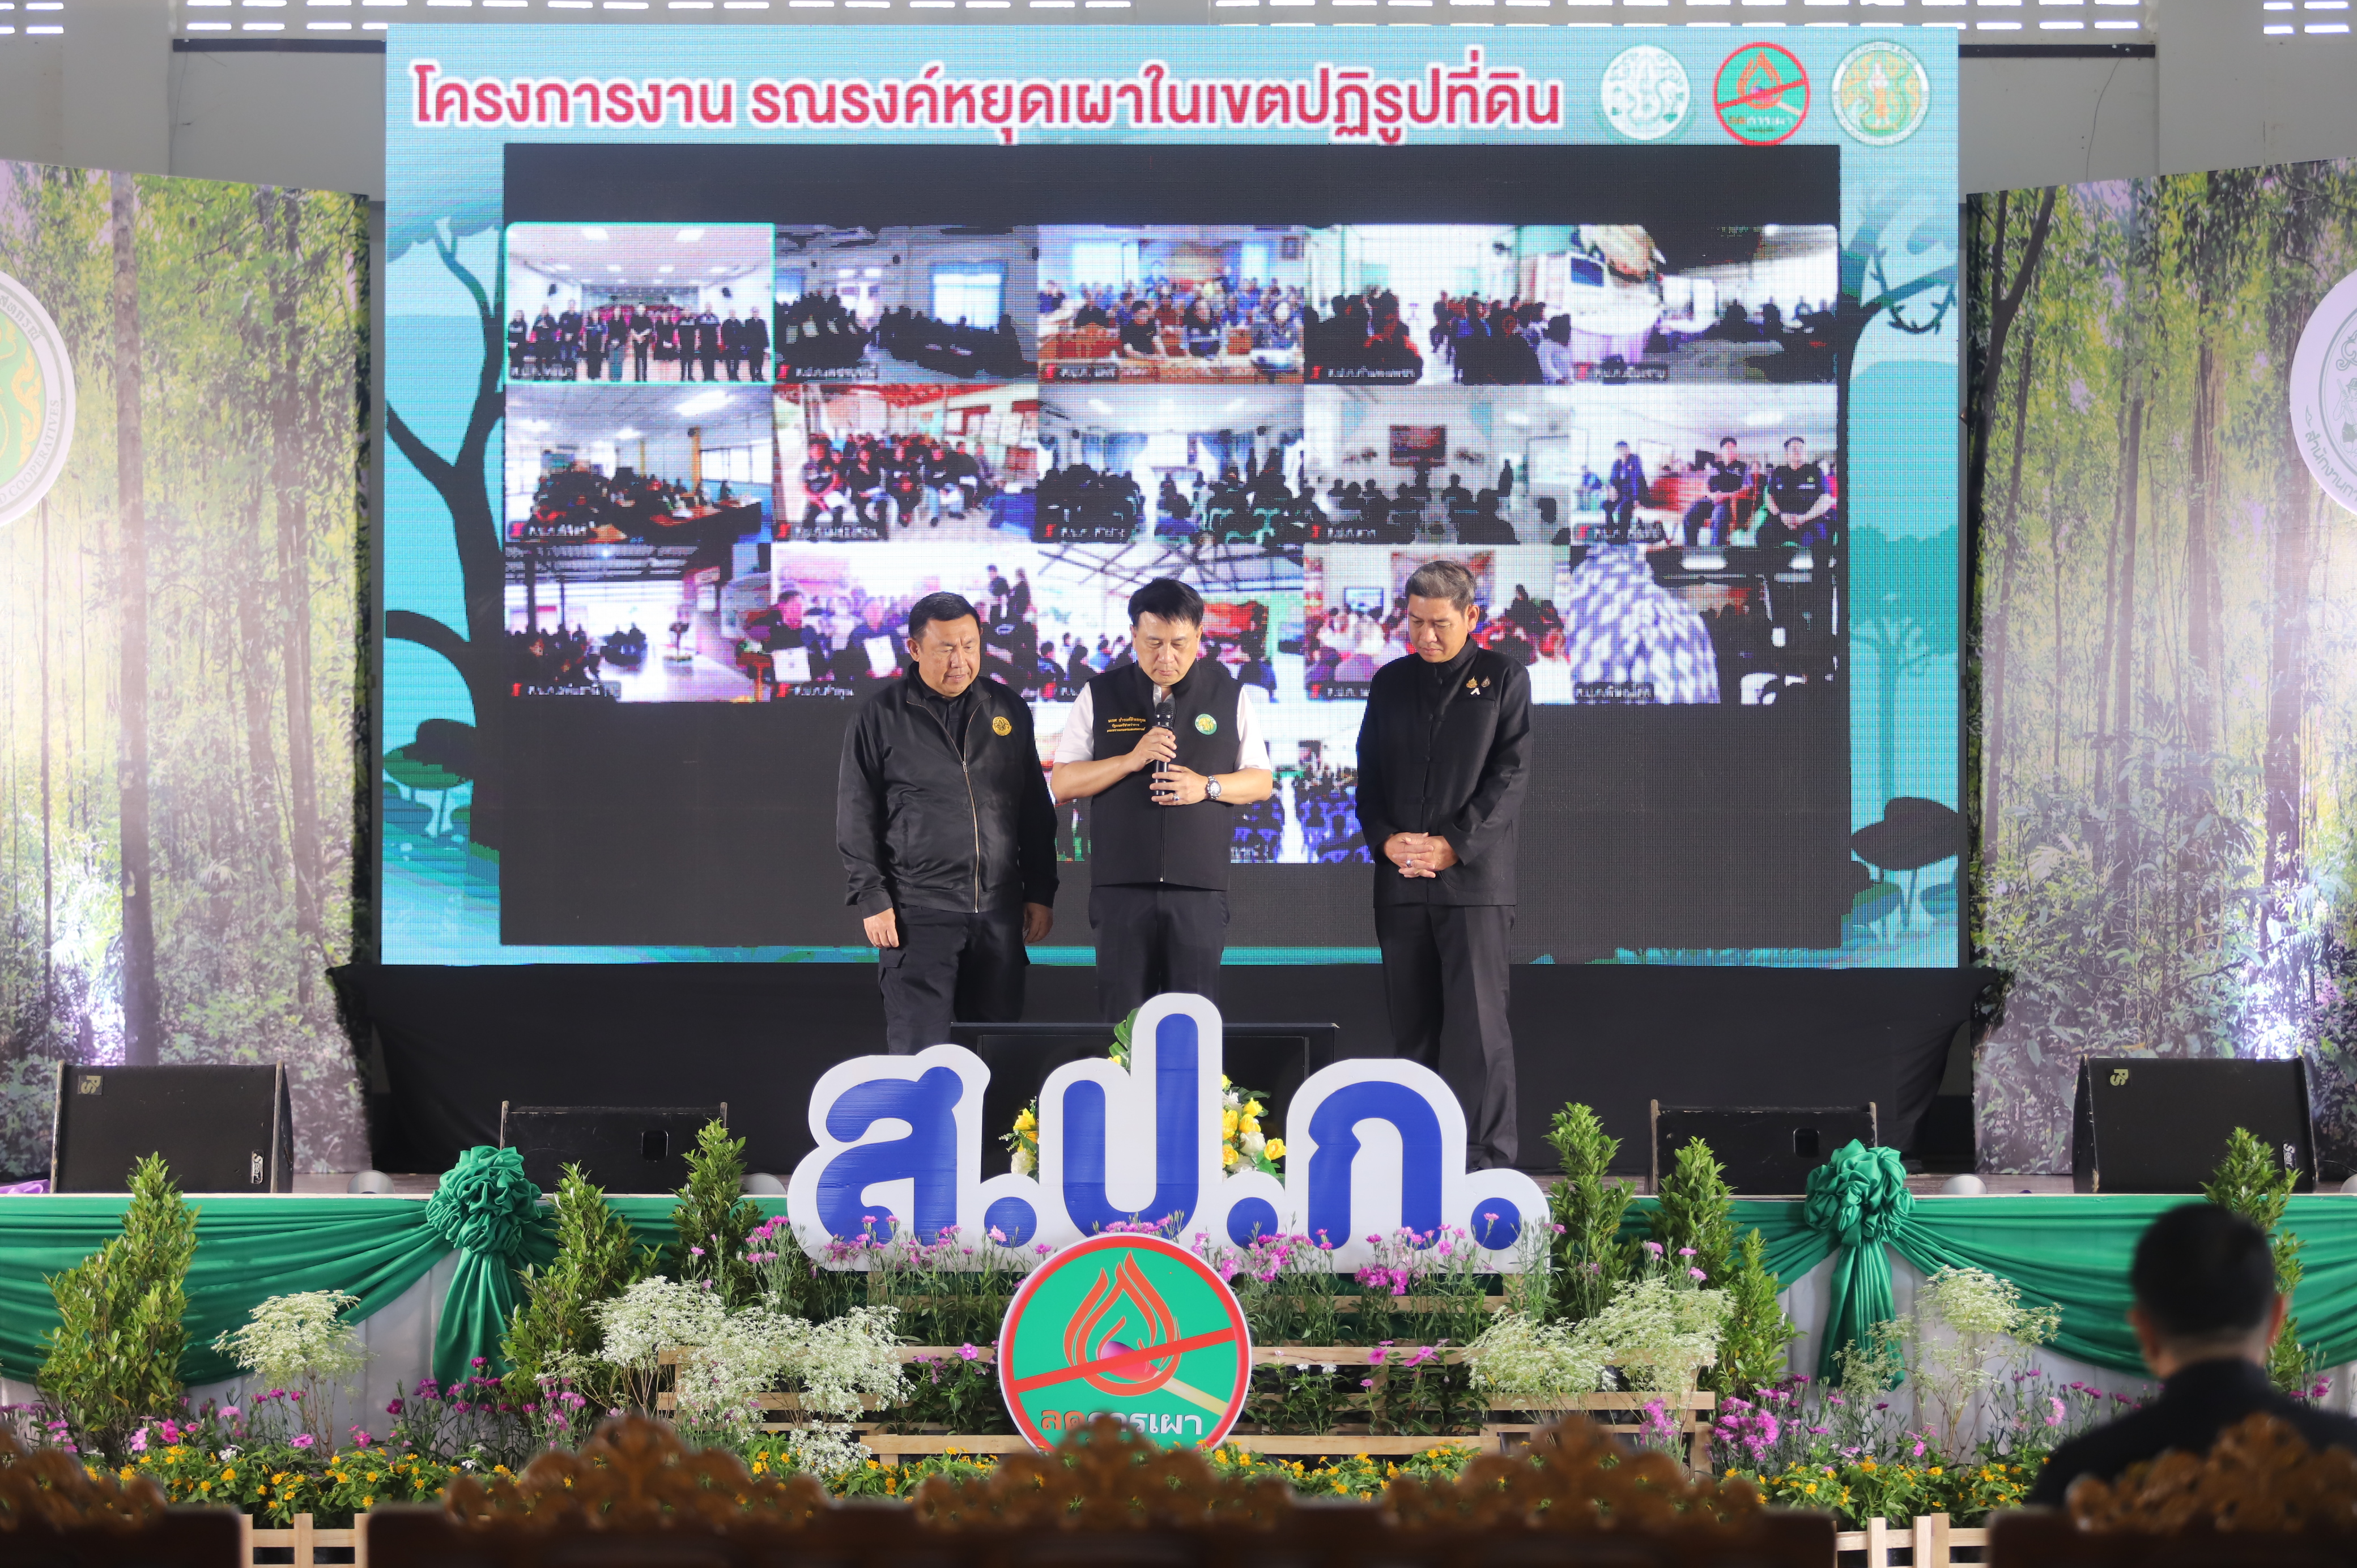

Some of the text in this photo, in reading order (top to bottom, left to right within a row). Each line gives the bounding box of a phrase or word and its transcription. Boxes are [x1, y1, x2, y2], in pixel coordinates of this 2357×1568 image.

[414, 48, 1559, 145] โครงการงาน รณรงค์หยุดเผาในเขตปฏิรูปที่ดิน
[8, 399, 59, 497] COOPERATIVES
[817, 1013, 1521, 1250] ส.ป.ก.
[2283, 1143, 2295, 1166] Seer
